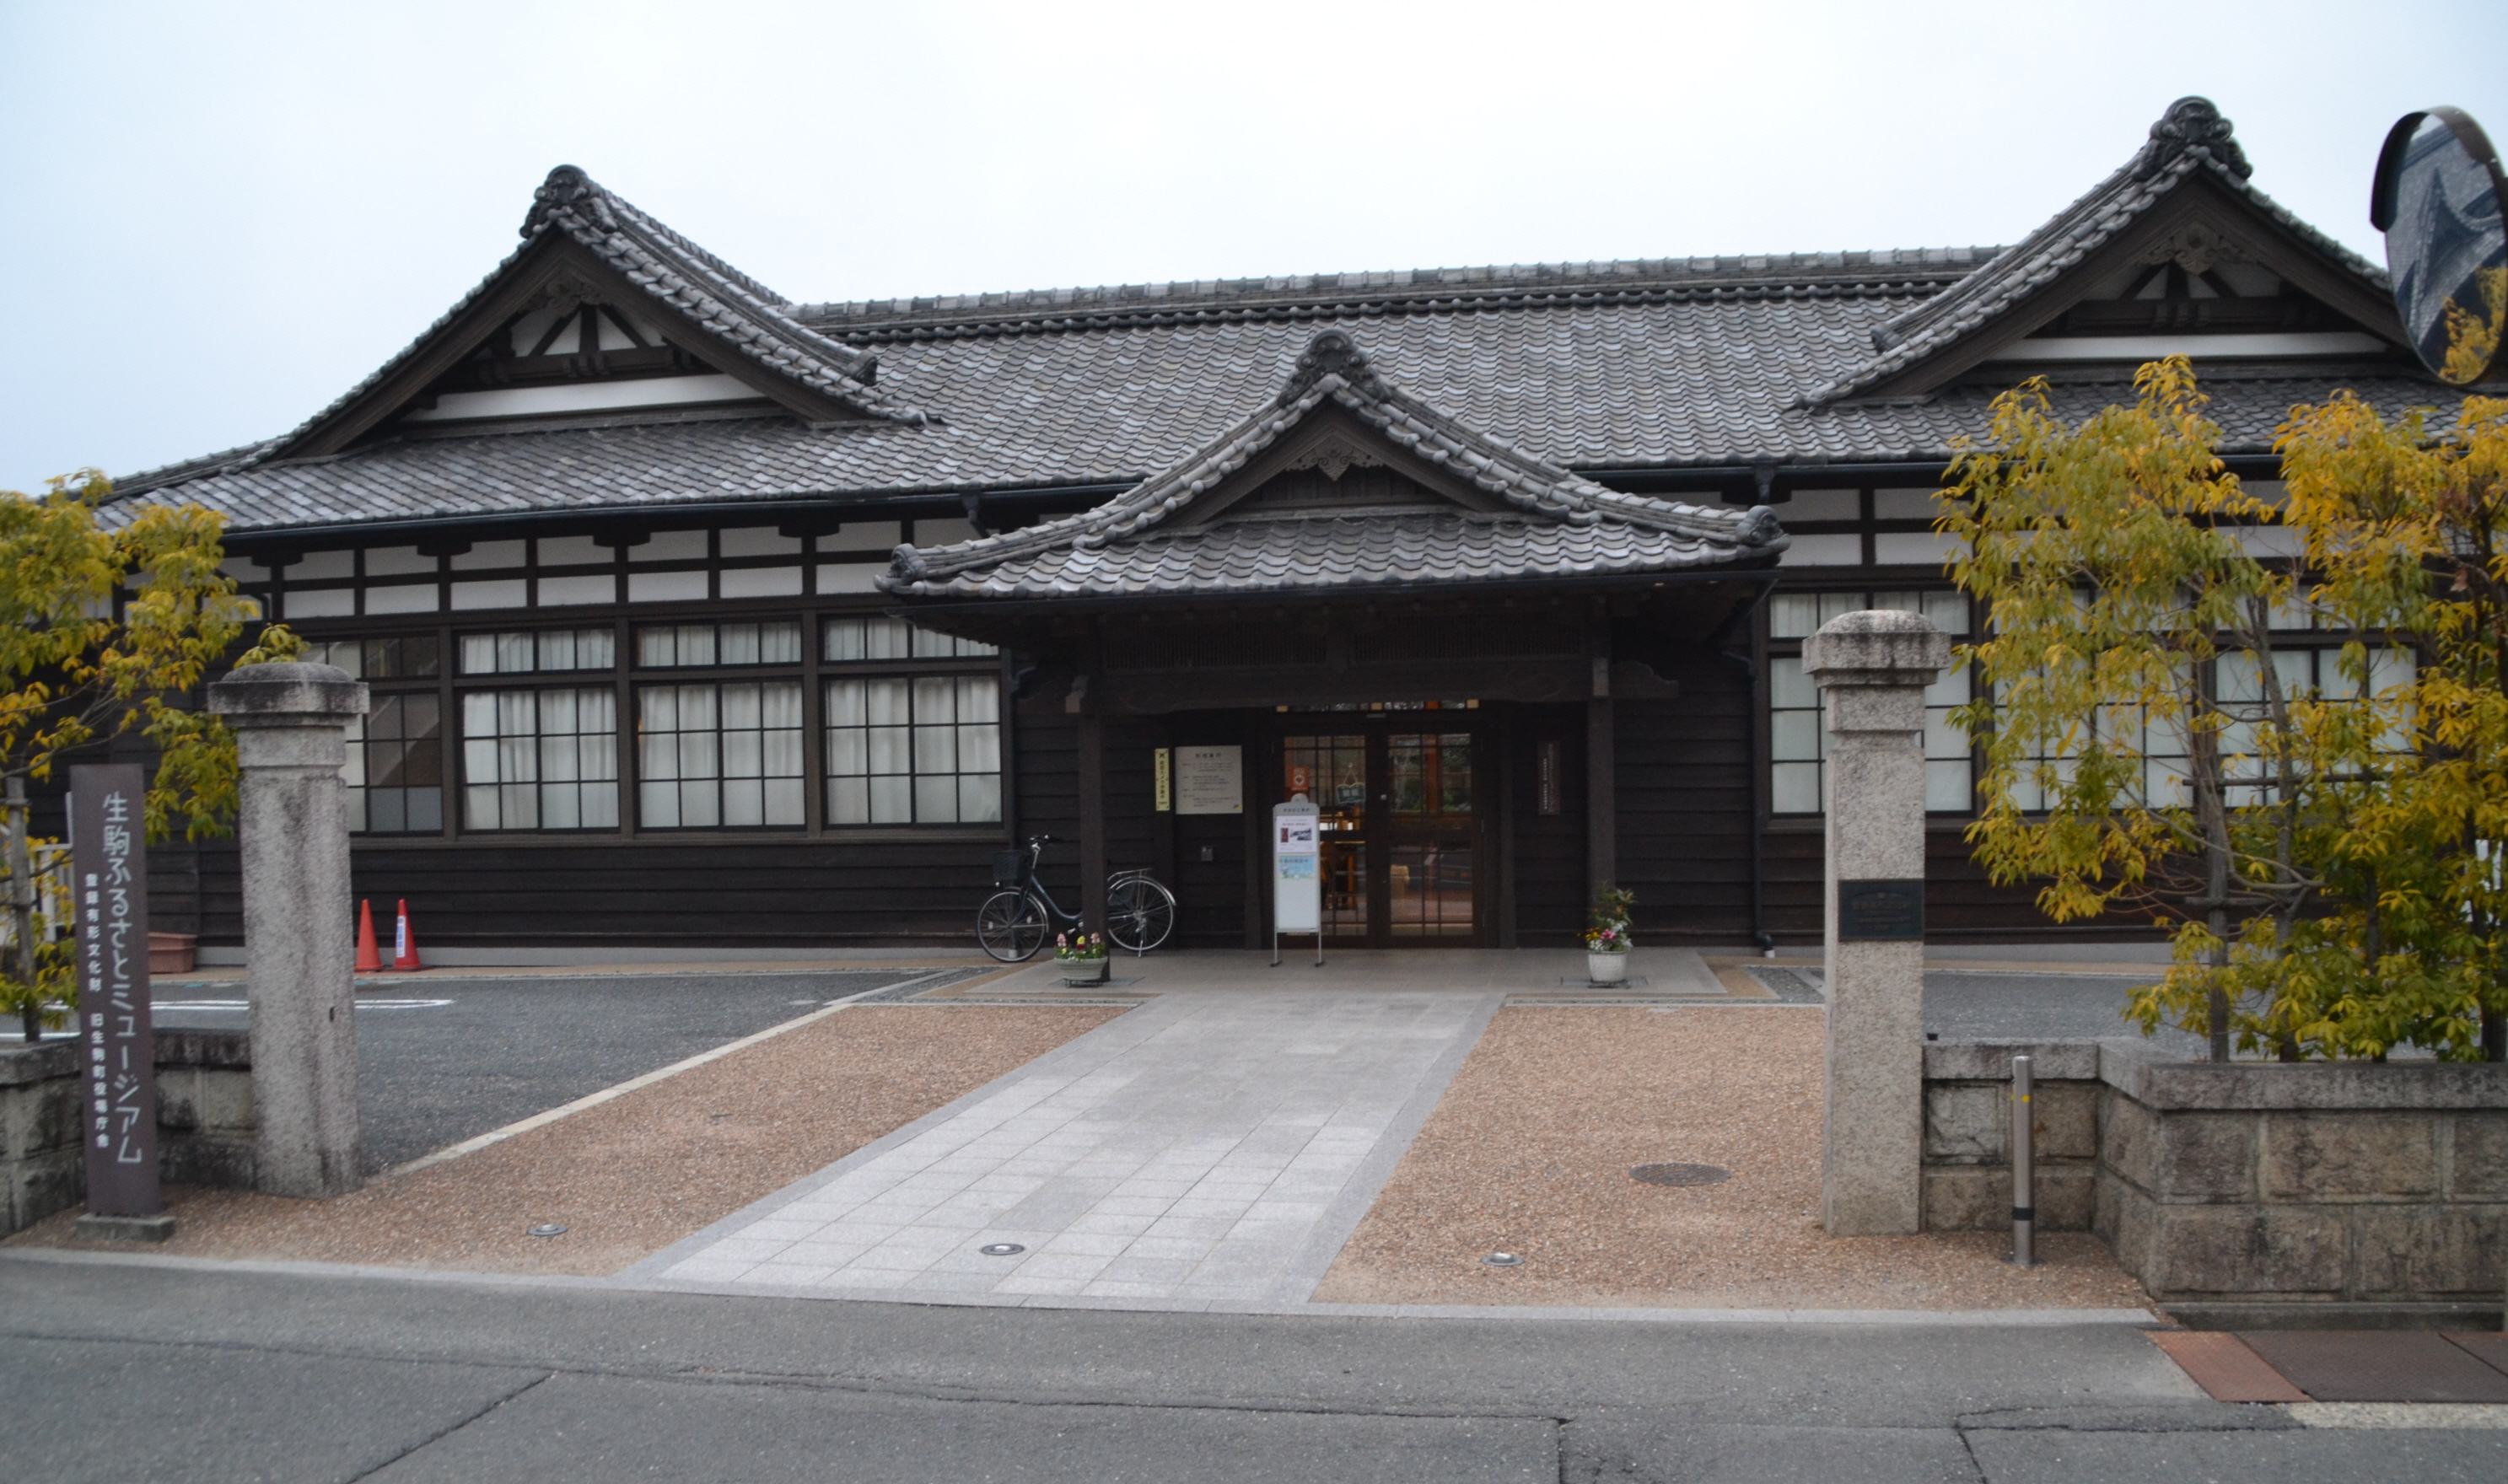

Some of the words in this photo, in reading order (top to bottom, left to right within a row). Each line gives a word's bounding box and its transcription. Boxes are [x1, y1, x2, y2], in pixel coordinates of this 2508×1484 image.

[84, 873, 102, 992] 登録有形文化財
[102, 790, 143, 1164] 生駒ふるさとミュージアム
